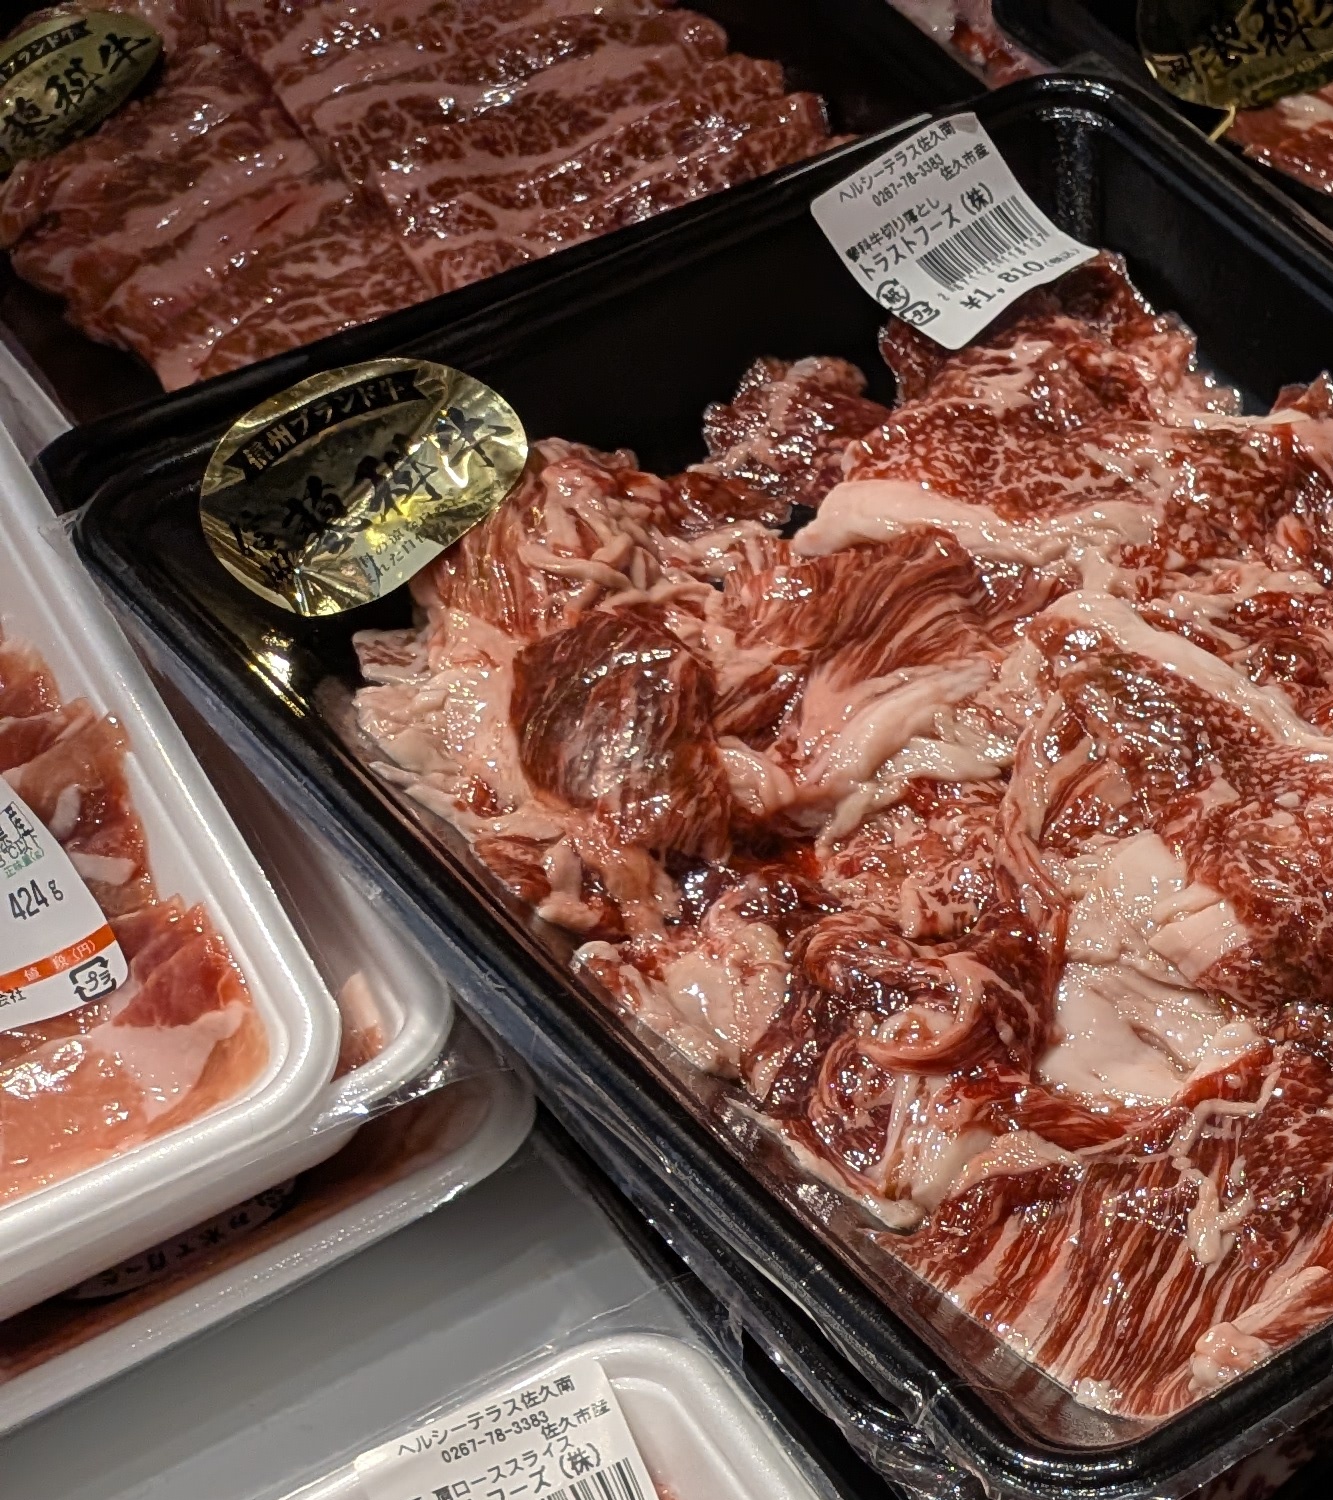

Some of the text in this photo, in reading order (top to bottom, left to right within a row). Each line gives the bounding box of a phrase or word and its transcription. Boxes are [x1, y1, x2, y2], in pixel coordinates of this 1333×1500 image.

[839, 120, 956, 203] ヘルシーテラス佐久南
[872, 154, 944, 207] 0267-78-3383
[939, 143, 990, 181] 佐久市産
[8, 879, 63, 920] 424 g
[398, 1375, 575, 1457] ヘルシーテラス佐久南
[442, 1411, 549, 1464] 0267-78-3383
[541, 1399, 611, 1440] 佐久市産
